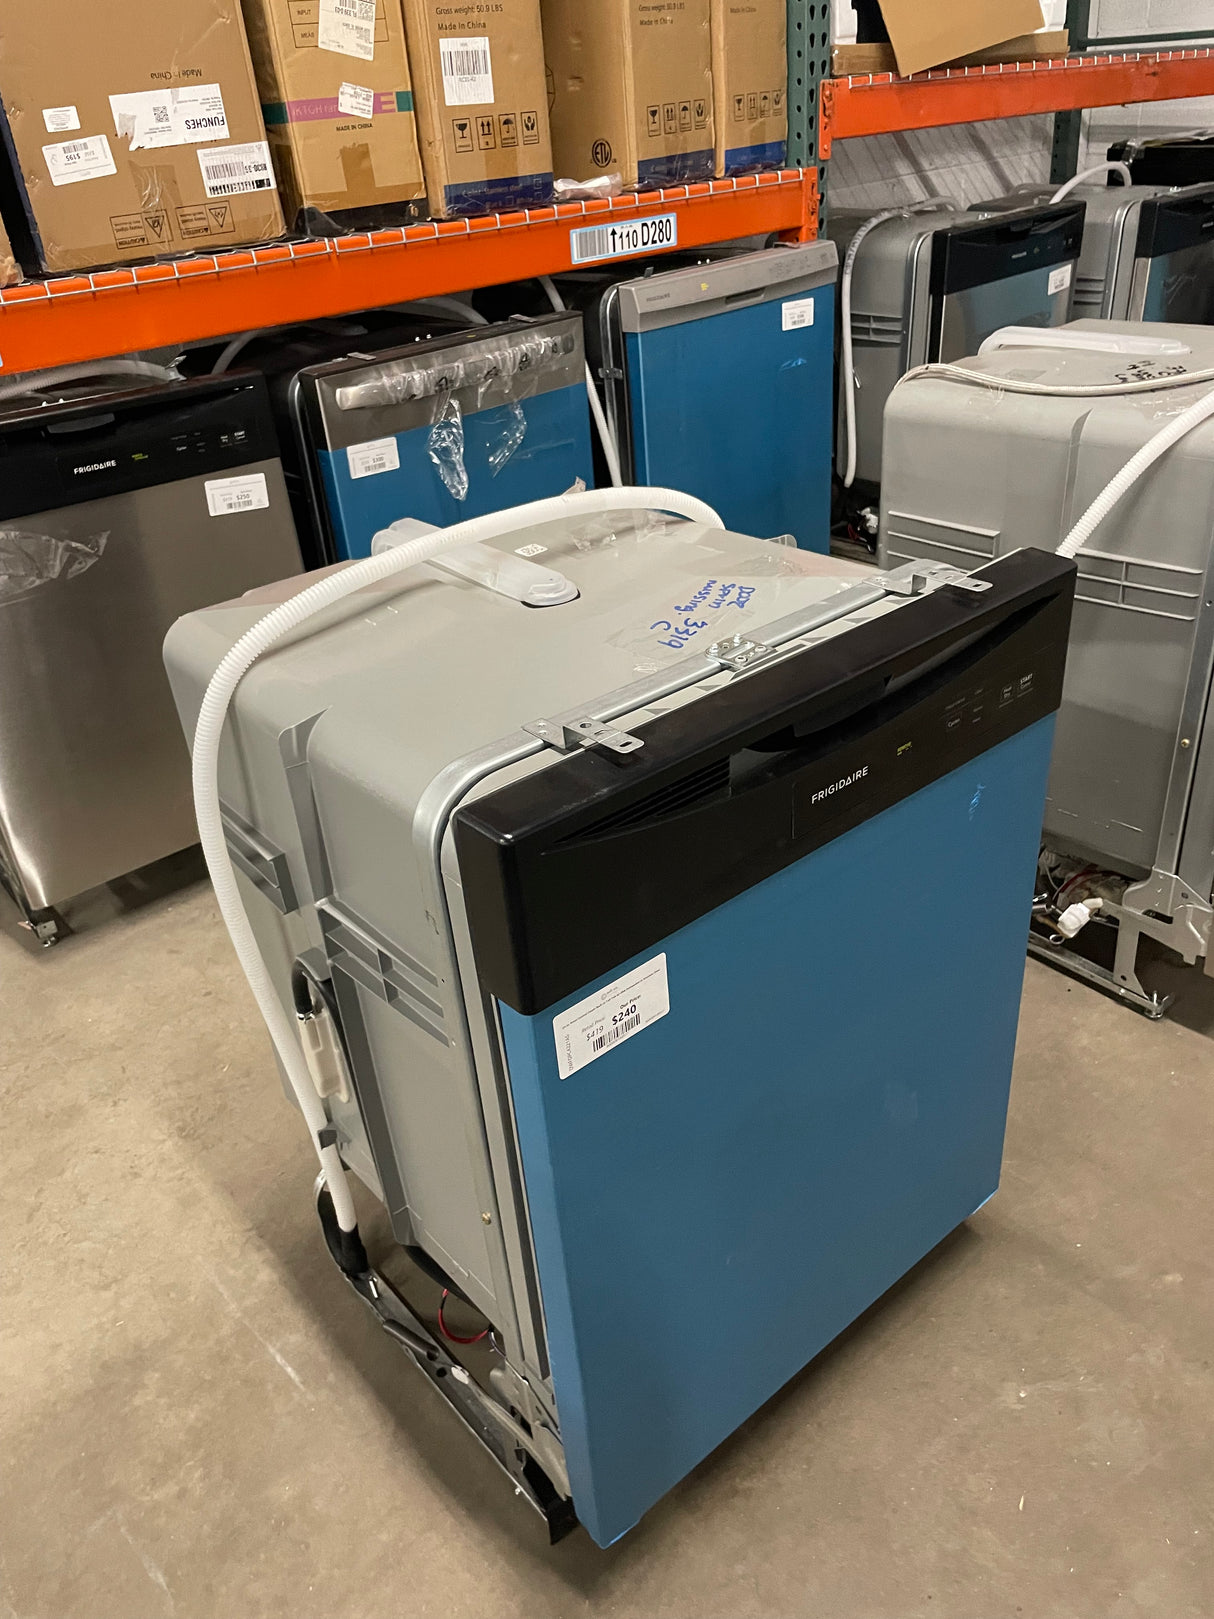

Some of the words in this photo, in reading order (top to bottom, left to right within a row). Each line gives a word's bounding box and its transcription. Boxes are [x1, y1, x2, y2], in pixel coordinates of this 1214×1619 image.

[437, 22, 456, 31] Made
[465, 21, 487, 30] China
[150, 71, 173, 81] China
[185, 115, 226, 130] FUNCHES
[336, 124, 351, 132] MADE
[357, 121, 373, 130] CHINA
[66, 153, 81, 162] $195
[618, 230, 639, 250] 110
[641, 218, 672, 246] D280
[73, 459, 117, 475] FRIGIDAIRE
[811, 765, 869, 804] FRIGIDAIRE
[611, 1004, 637, 1026] $240
[586, 1025, 604, 1041] $419
